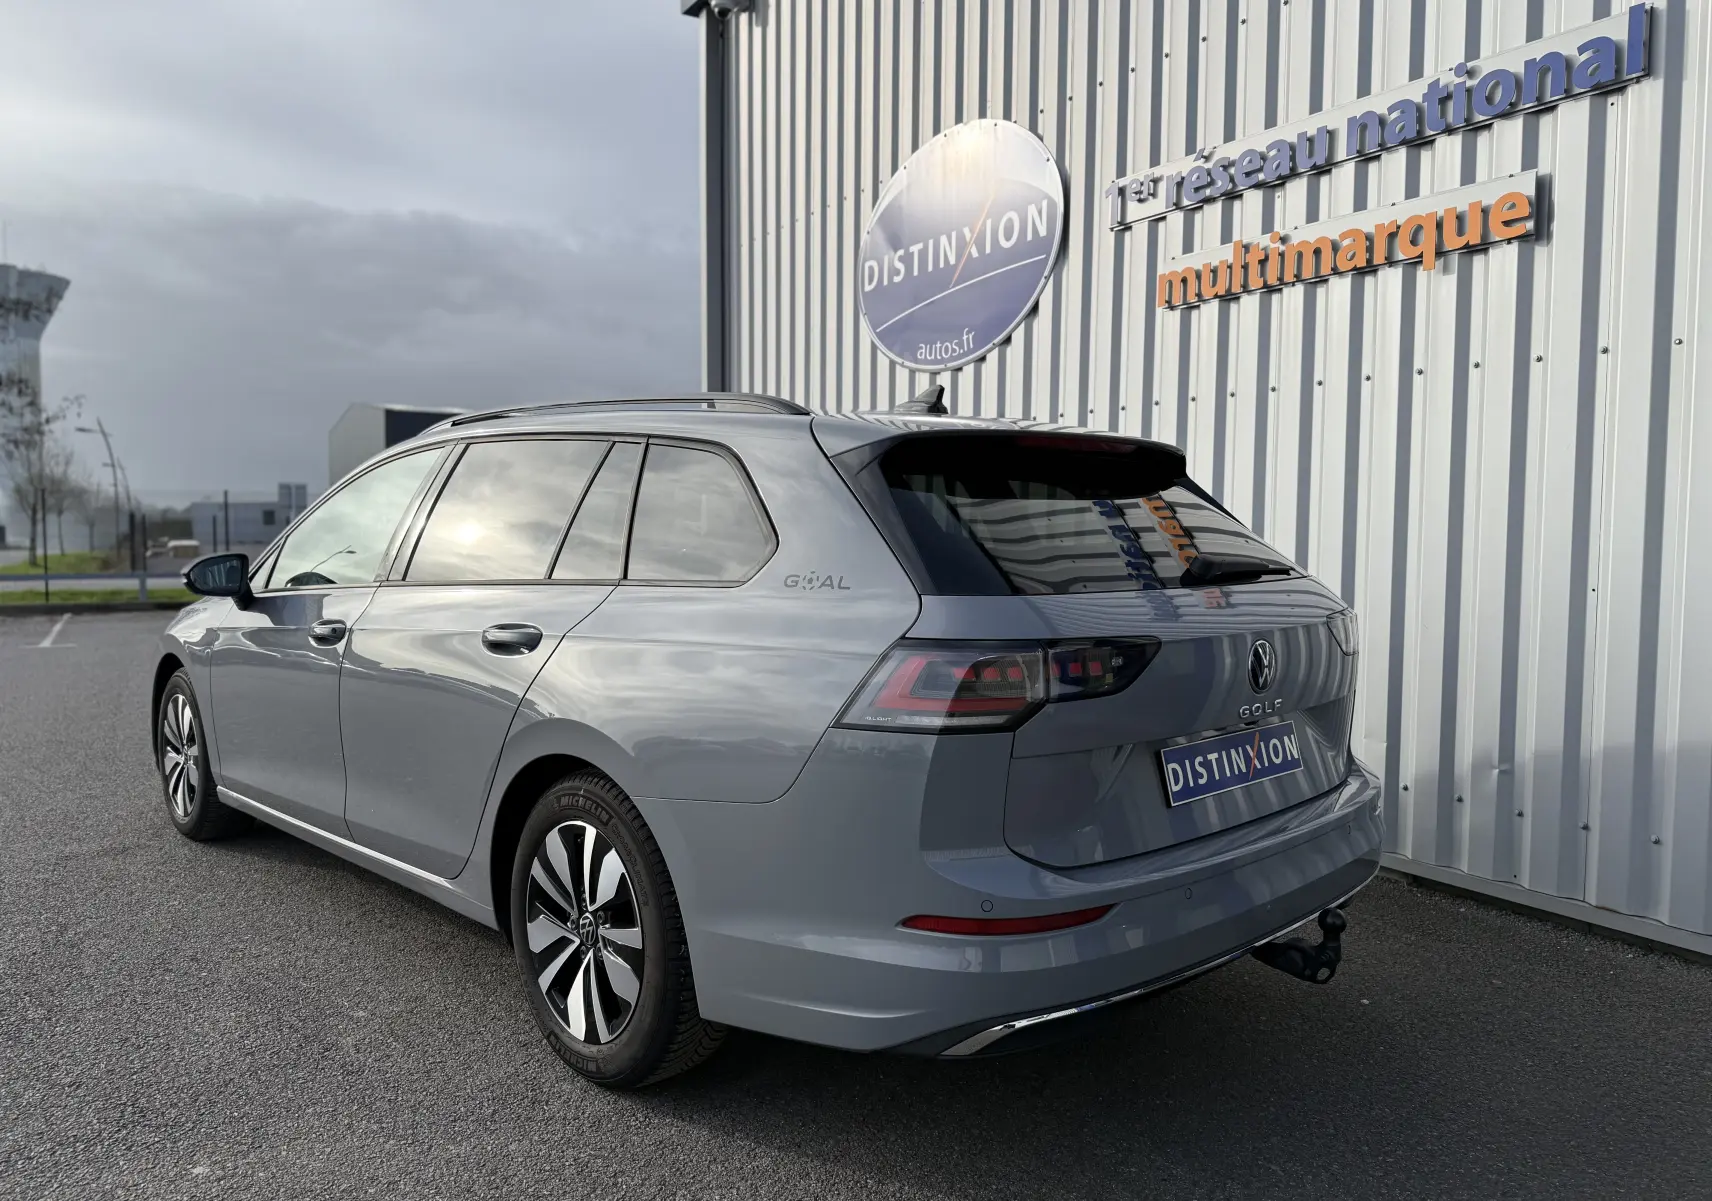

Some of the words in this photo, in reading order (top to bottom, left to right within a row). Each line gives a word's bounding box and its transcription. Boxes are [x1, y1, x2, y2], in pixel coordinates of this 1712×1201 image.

[1164, 125, 1328, 210] réseau
[1345, 2, 1646, 157] national
[863, 198, 1048, 292] DISTINXION
[1157, 191, 1531, 308] multimarque
[916, 328, 975, 360] autos.fr
[1239, 698, 1283, 719] GOLF
[1167, 732, 1299, 792] DISTINXION
[560, 794, 611, 823] MICHELIN
